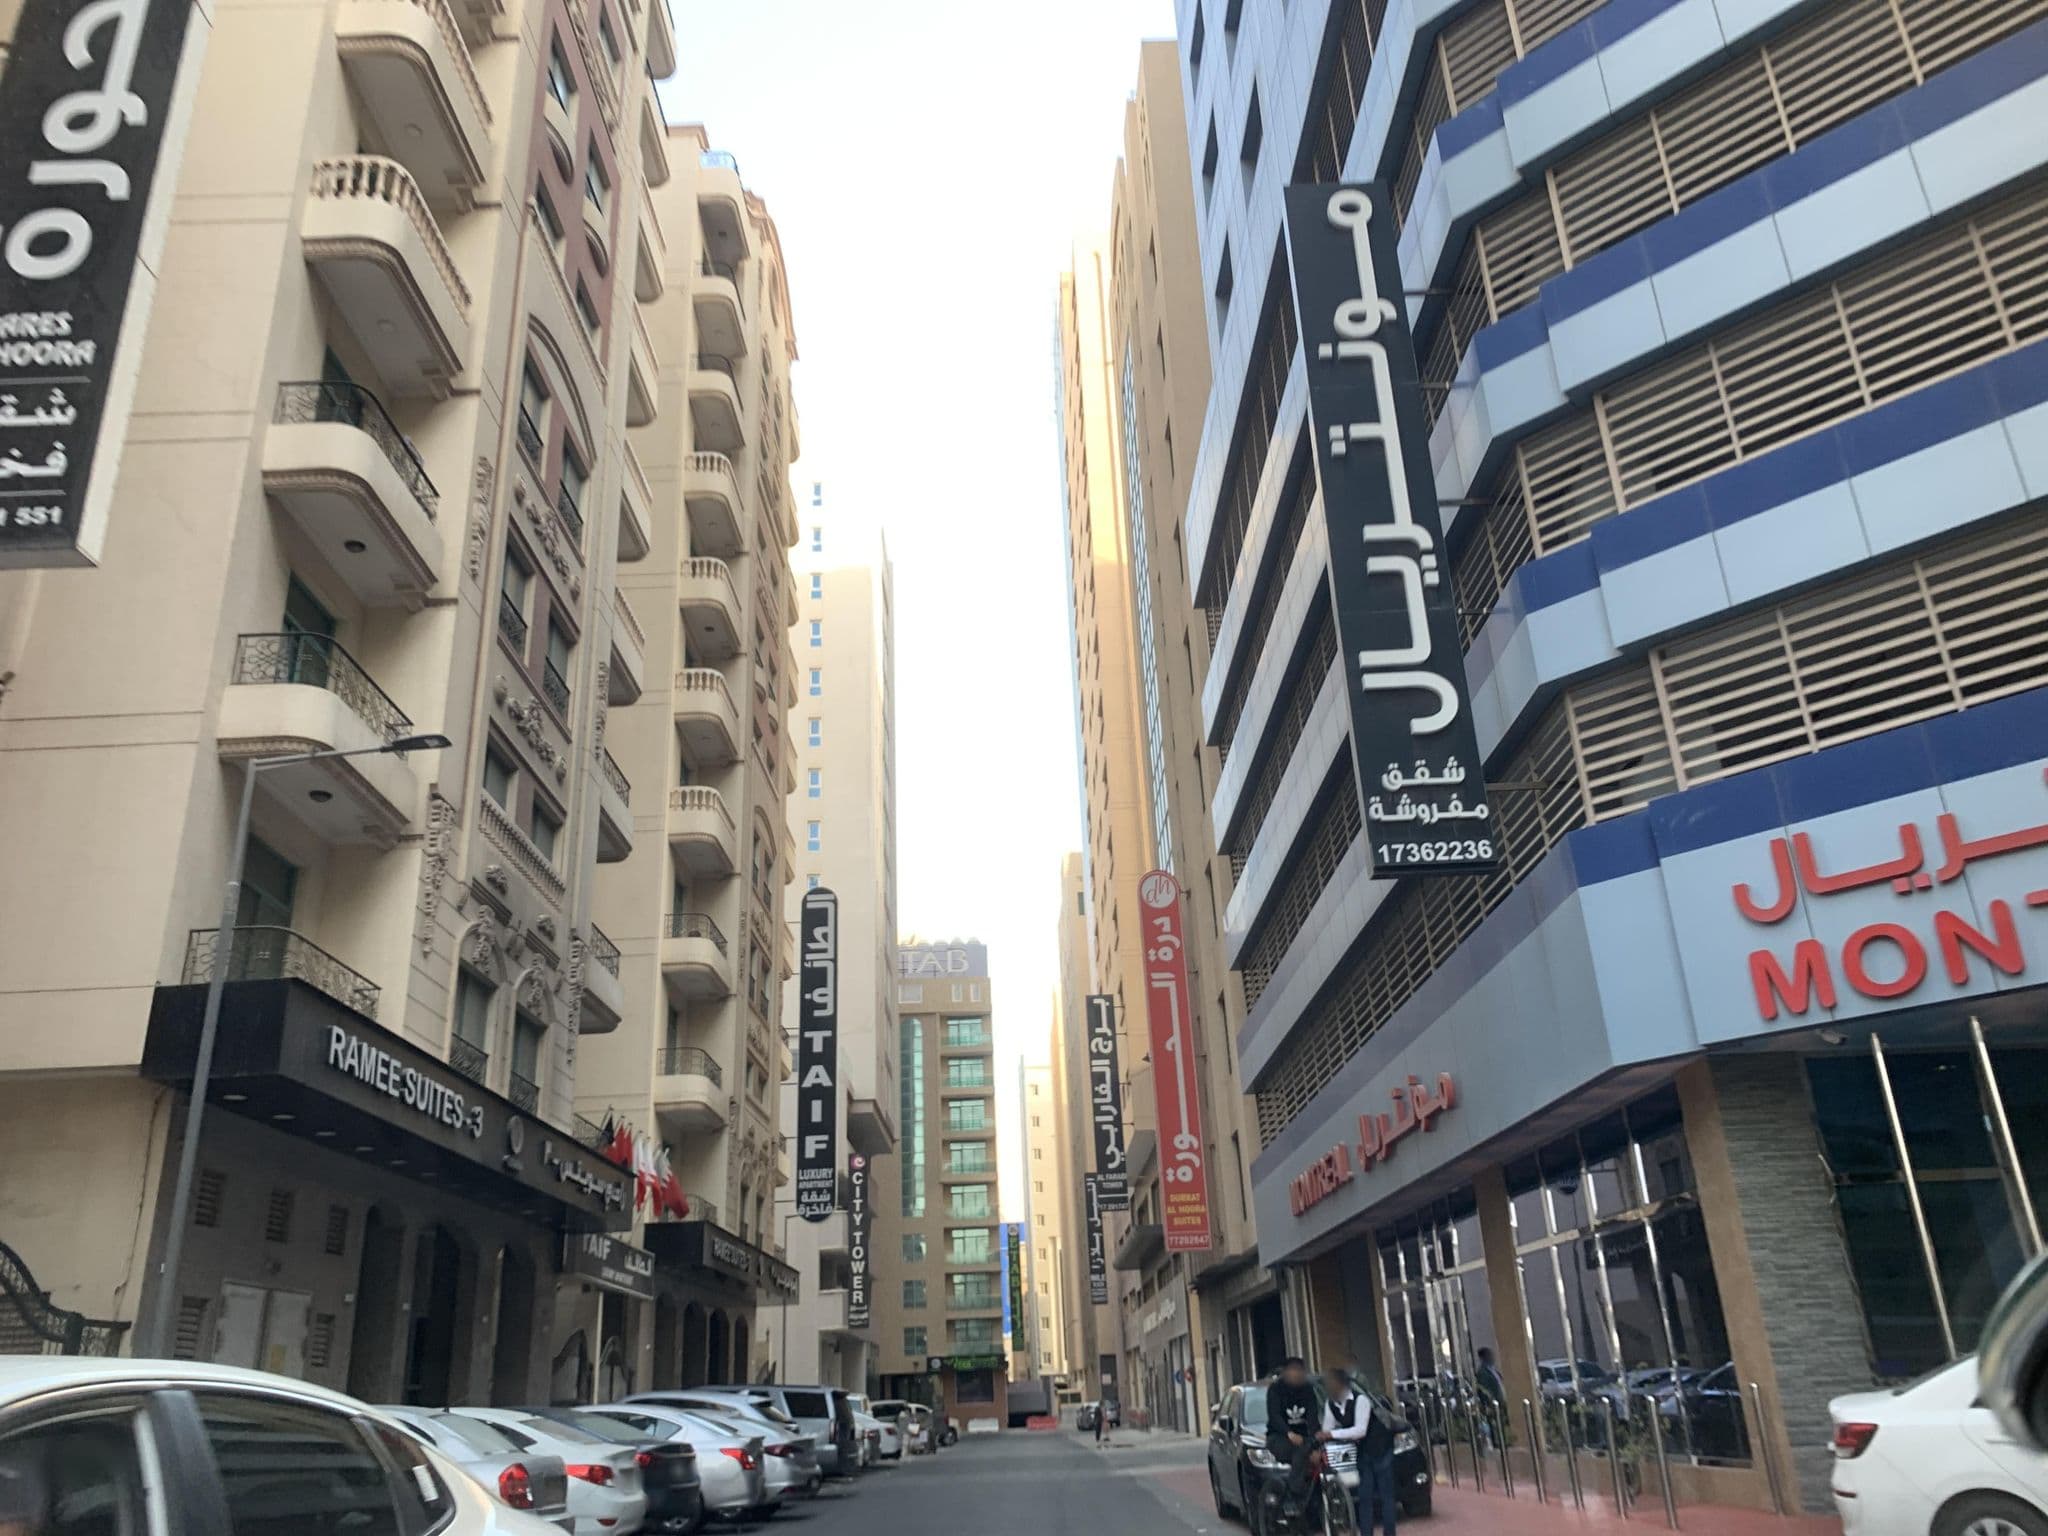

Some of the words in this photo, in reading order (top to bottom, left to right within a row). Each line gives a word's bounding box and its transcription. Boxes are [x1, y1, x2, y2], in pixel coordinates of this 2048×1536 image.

[0, 311, 74, 339] ARES
[0, 387, 77, 427] شق
[1318, 188, 1460, 736] مونتريال
[1381, 755, 1466, 791] شقق
[1368, 792, 1490, 825] مفروشة
[1378, 839, 1493, 864] 17362236
[1732, 767, 2048, 924] ريال
[804, 893, 836, 1017] الطائف
[1148, 915, 1181, 961] درة
[1748, 888, 2048, 1021] MON
[1090, 997, 1114, 1054] برج
[329, 1025, 402, 1098] RAMEE
[802, 1029, 834, 1159] TAIF
[1092, 1059, 1127, 1169] الفارابي
[798, 1168, 834, 1180] LUXURY
[852, 1171, 864, 1227] CITY
[850, 1231, 866, 1305] TOWER
